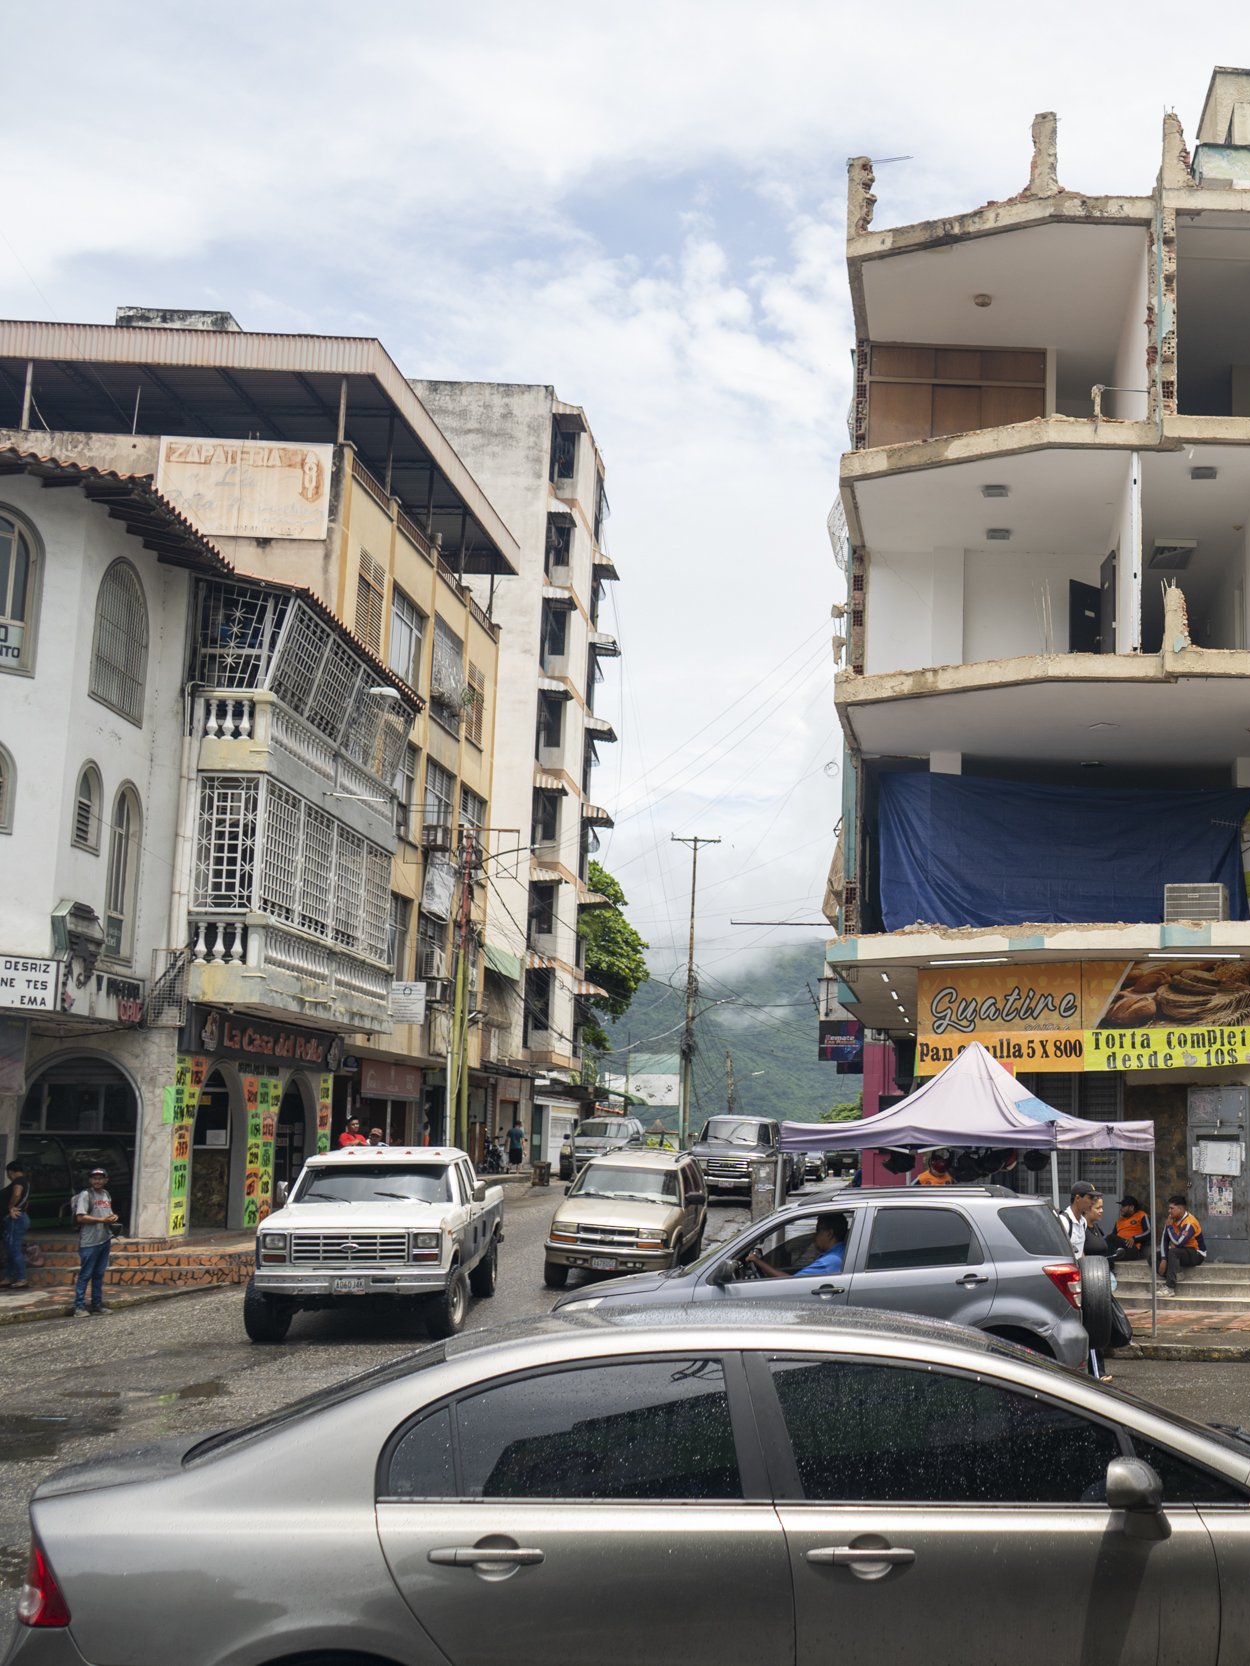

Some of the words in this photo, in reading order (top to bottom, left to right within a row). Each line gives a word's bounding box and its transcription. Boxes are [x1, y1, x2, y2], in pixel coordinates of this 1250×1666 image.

[168, 443, 282, 467] ZAPATERIA
[4, 960, 51, 974] DESRIZ
[25, 979, 49, 990] TES
[931, 986, 1077, 1034] Guatire
[224, 1021, 241, 1049] La
[243, 1027, 274, 1055] Casa
[275, 1033, 296, 1058] del
[295, 1036, 323, 1063] Pollo
[919, 1042, 954, 1063] Pan
[1026, 1039, 1035, 1056] 5
[1039, 1039, 1050, 1059] X
[1054, 1038, 1083, 1058] 800
[1092, 1031, 1152, 1050] Torta
[1107, 1050, 1174, 1070] desde
[1204, 1047, 1239, 1068] 10$
